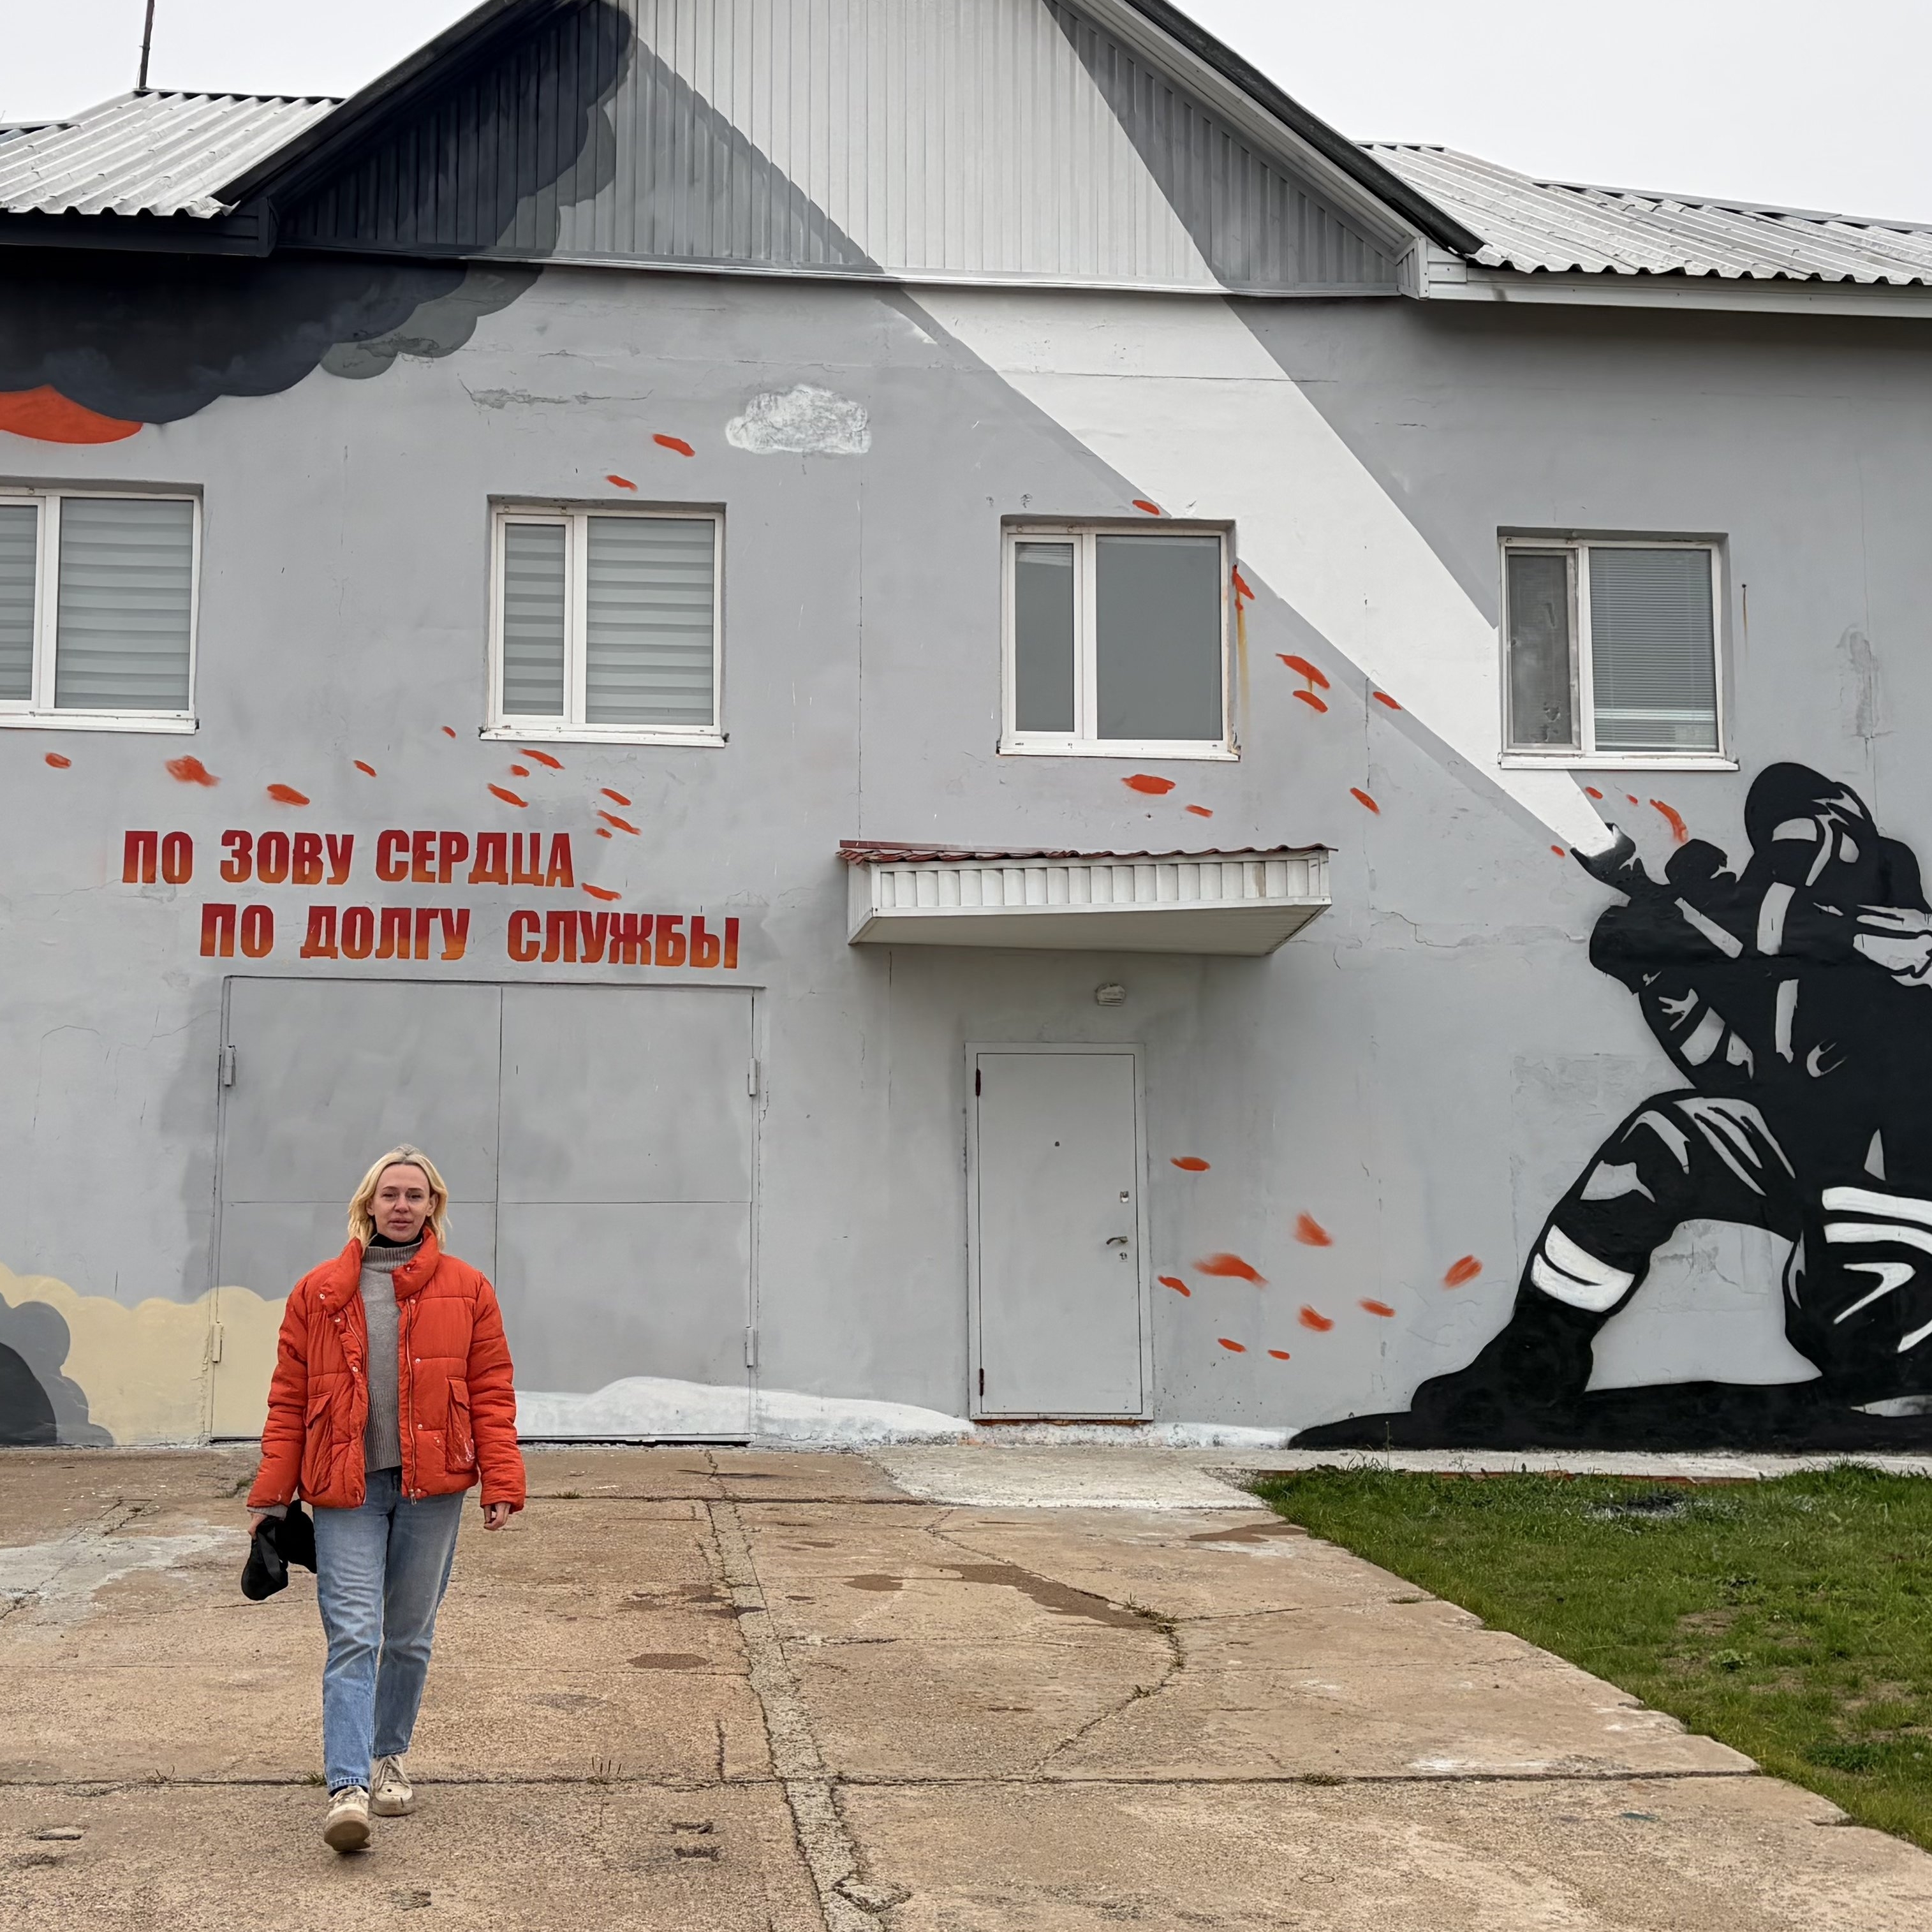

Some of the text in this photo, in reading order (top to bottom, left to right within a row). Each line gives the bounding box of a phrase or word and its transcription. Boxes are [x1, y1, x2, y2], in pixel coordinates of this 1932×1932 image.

[122, 830, 574, 888] ПО ЗОВУ СЕРДЦА
[200, 903, 739, 969] ПО ДОЛГУ СЛУЖБЫ
